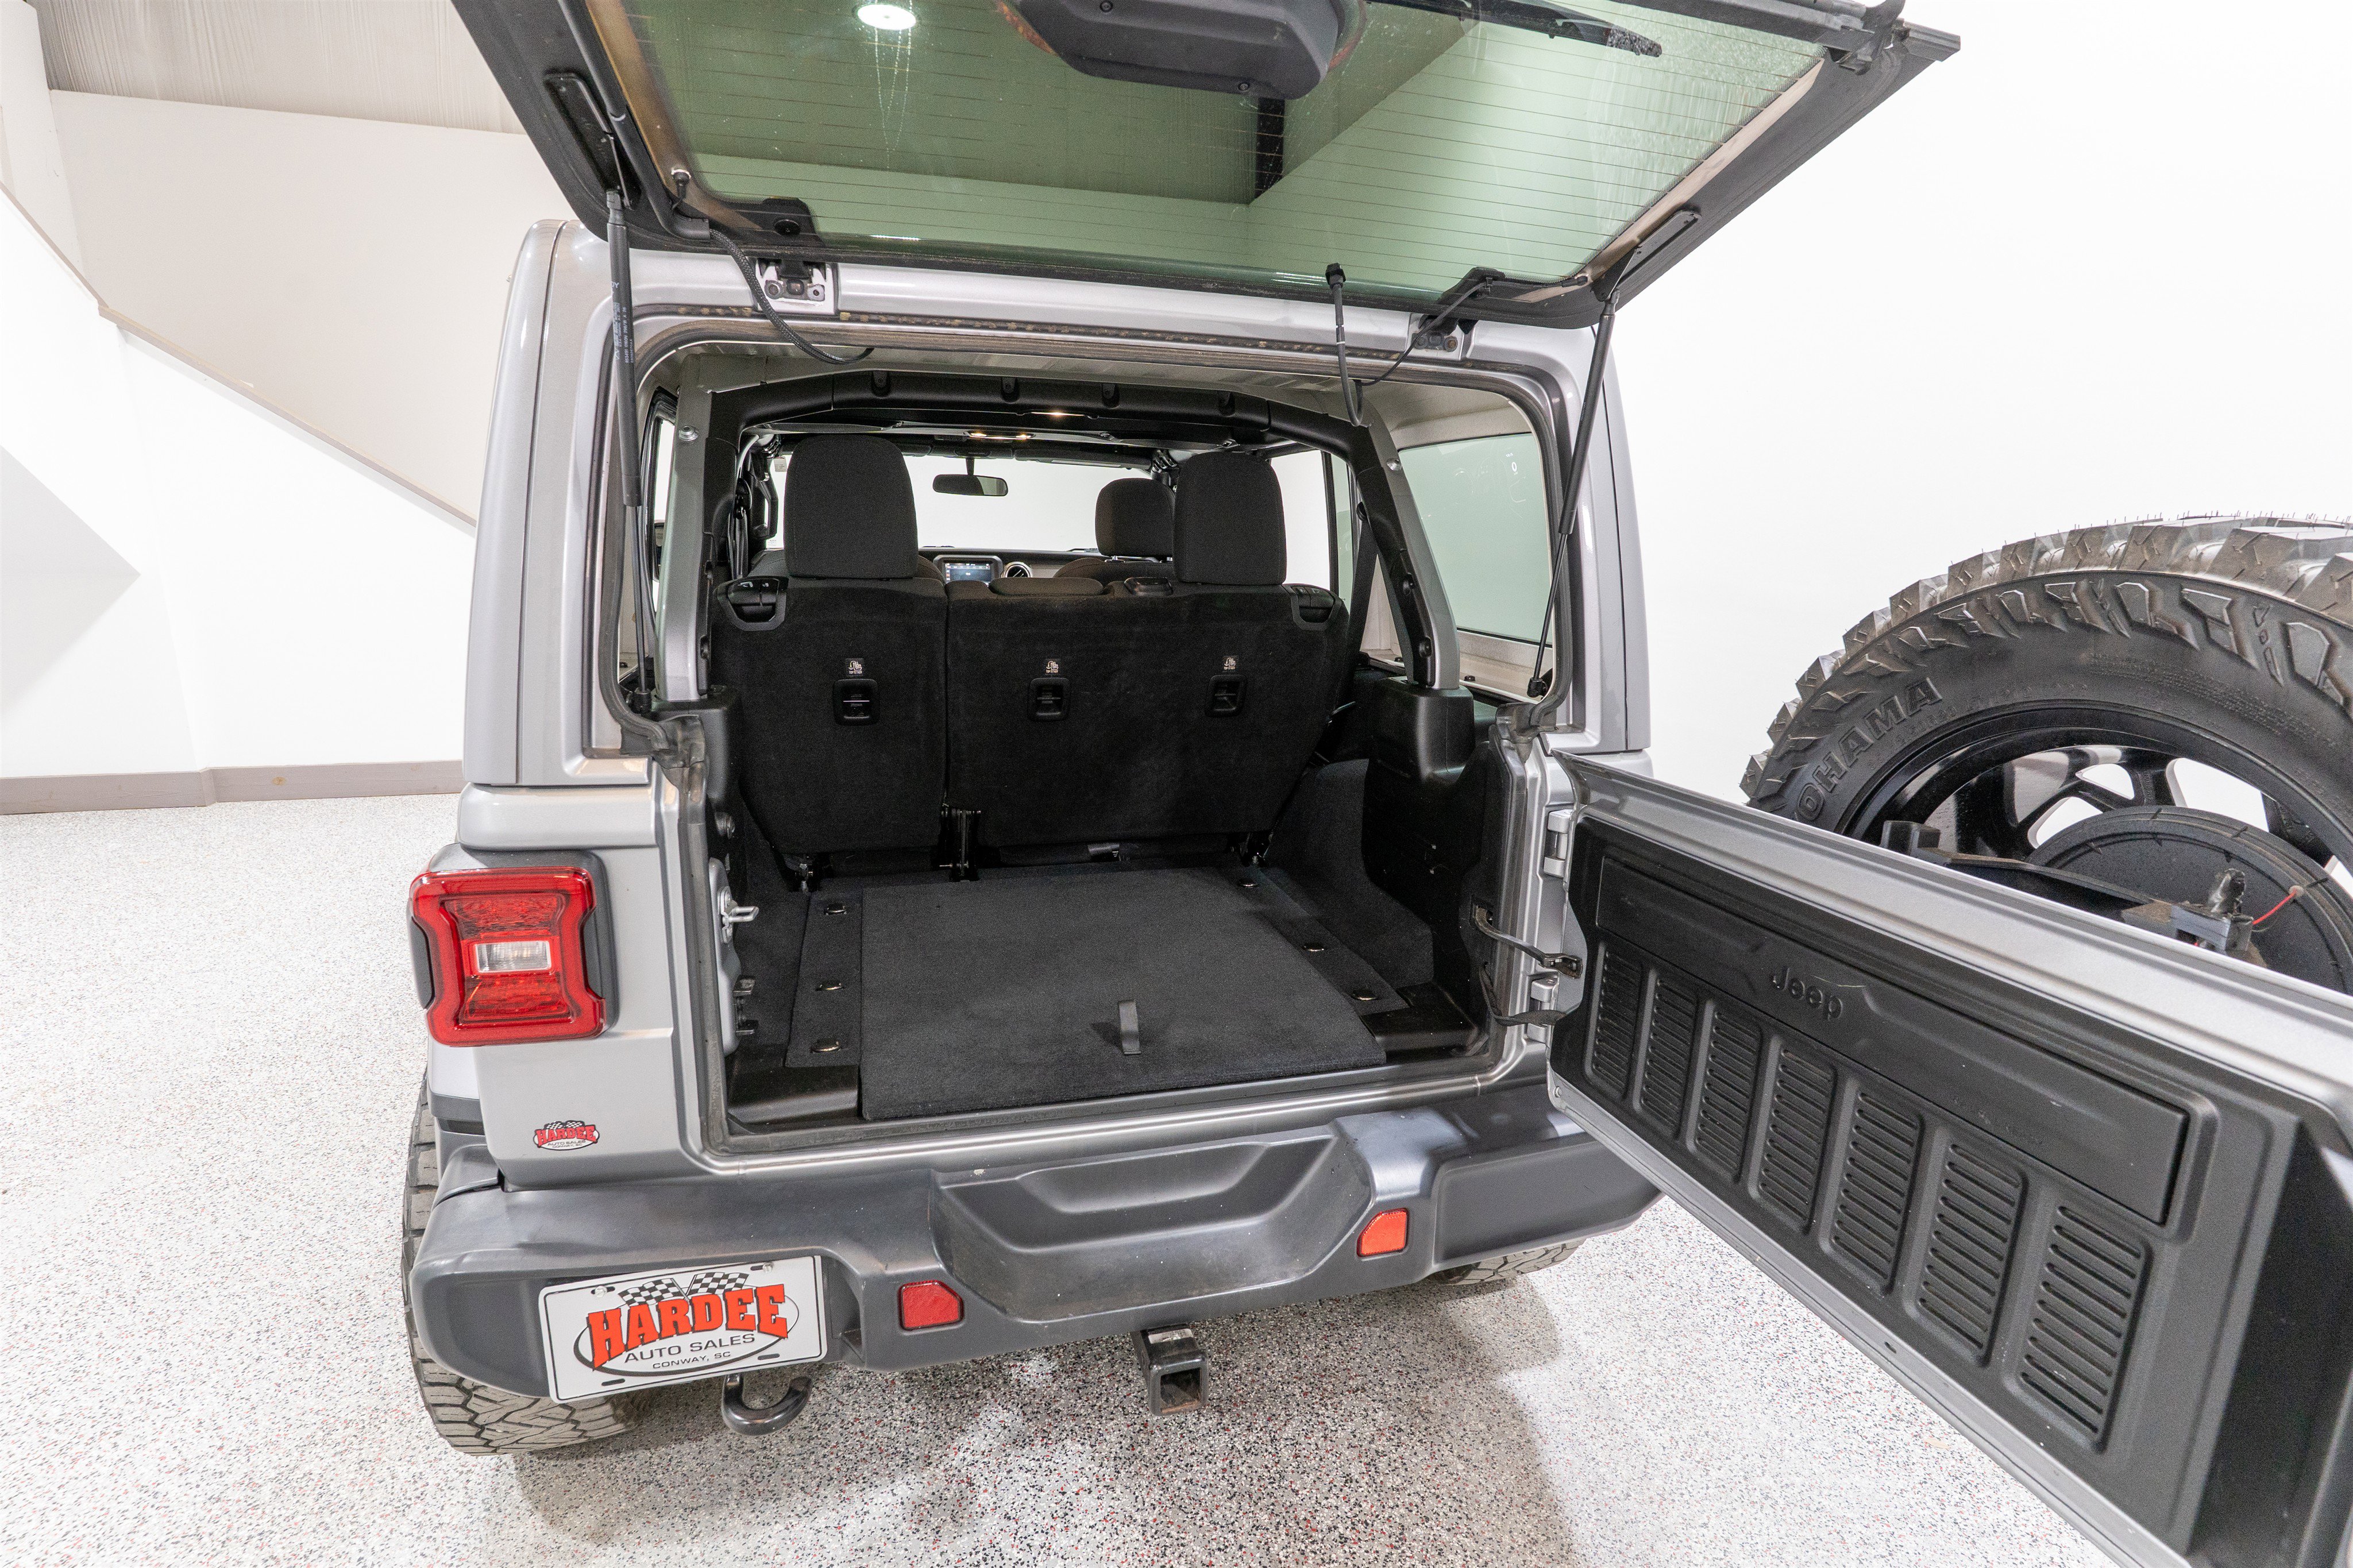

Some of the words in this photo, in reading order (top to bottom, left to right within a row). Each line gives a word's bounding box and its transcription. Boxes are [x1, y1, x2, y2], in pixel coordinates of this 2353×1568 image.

[1795, 677, 1942, 821] OHAMA
[1771, 966, 1844, 1021] Jeep
[535, 1125, 597, 1146] HARDEE
[586, 1284, 788, 1371] HARDEE
[624, 1345, 682, 1364] AUTO
[689, 1333, 755, 1353] SALES
[652, 1355, 709, 1369] CONWAY,
[714, 1351, 731, 1359] SC
